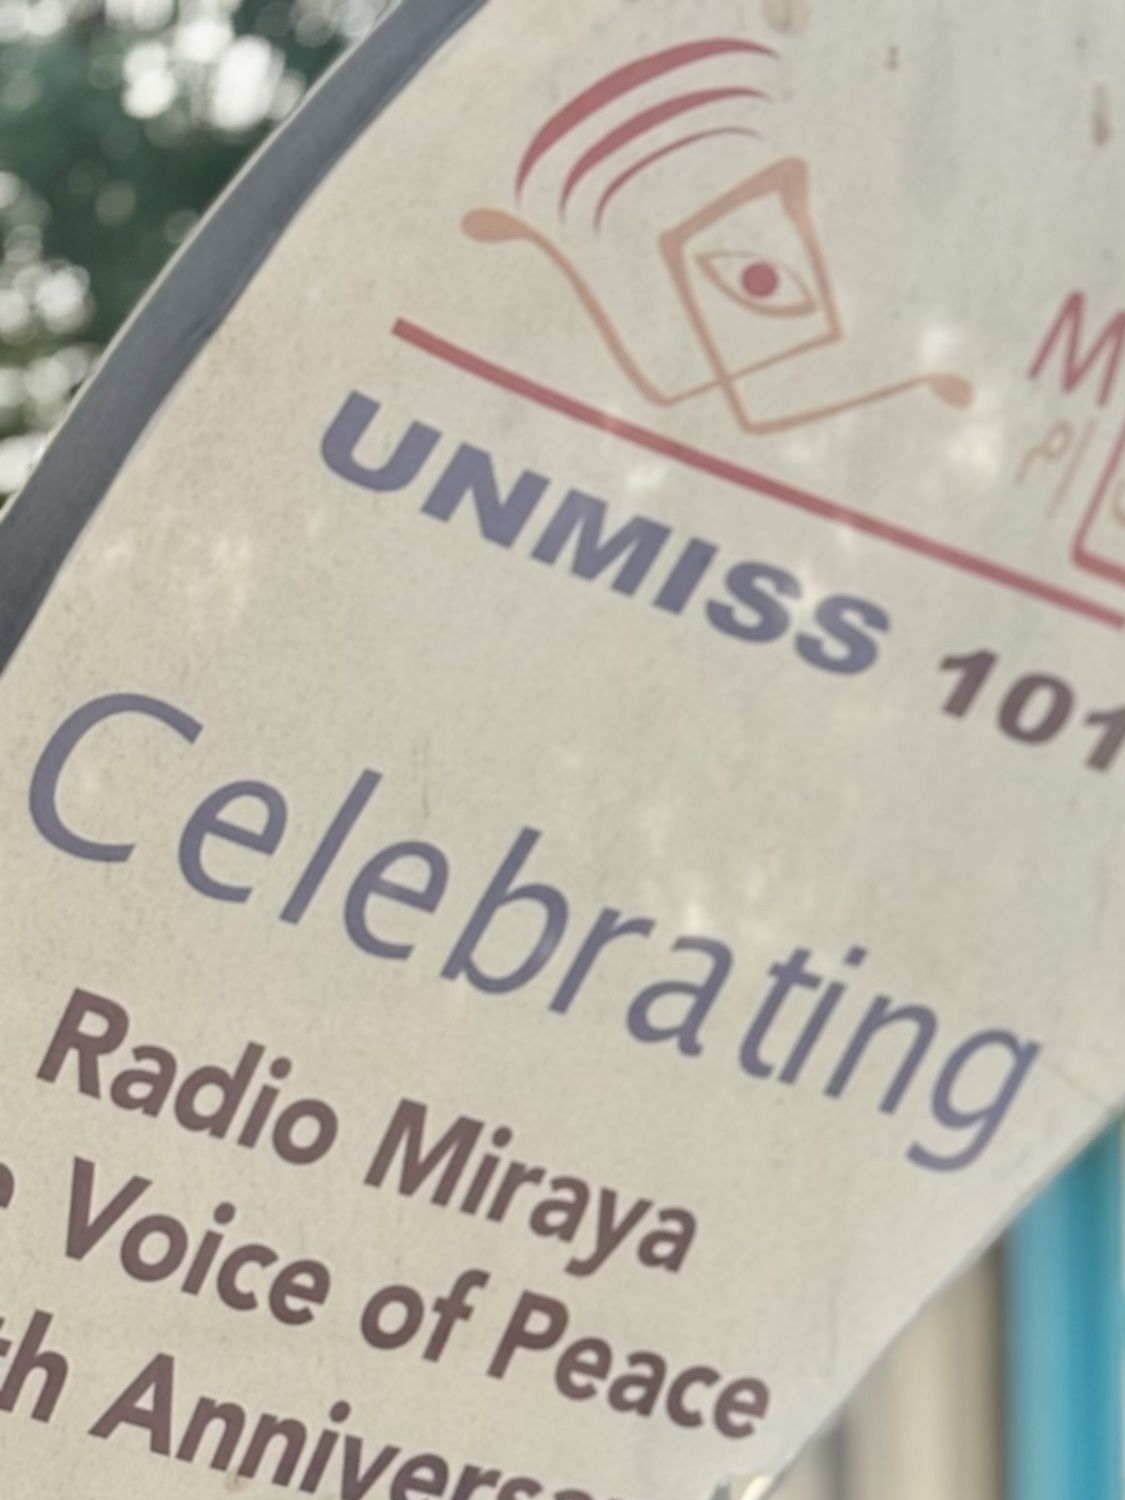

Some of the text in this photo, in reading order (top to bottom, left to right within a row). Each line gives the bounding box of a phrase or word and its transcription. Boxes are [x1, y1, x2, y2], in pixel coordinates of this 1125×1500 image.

[319, 390, 891, 676] UNMISS
[28, 692, 1042, 1173] Celebrating
[36, 987, 698, 1279] Radio Miraya
[64, 1155, 772, 1441] Voice of Peace
